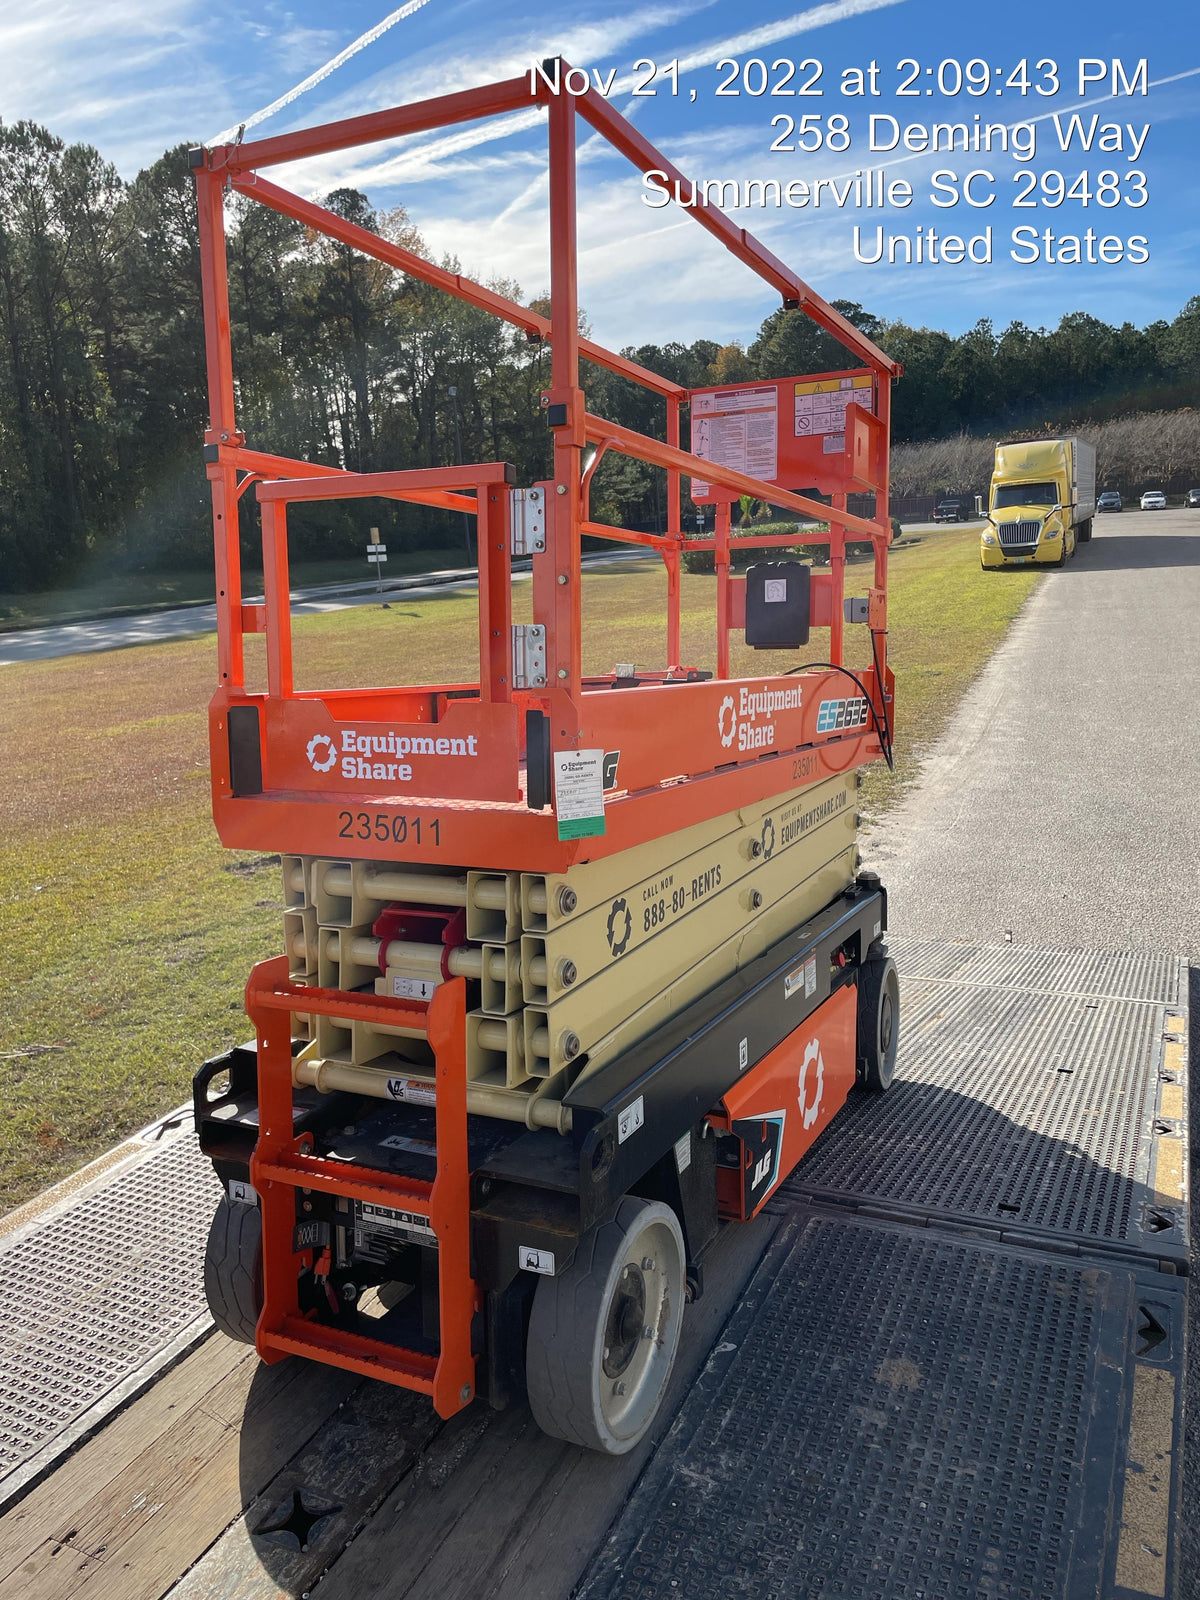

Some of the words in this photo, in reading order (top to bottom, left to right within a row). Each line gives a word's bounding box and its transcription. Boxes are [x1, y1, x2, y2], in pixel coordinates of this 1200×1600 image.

[739, 685, 803, 718] Equipment
[816, 696, 869, 734] ES2632
[341, 730, 478, 759] Equipment
[738, 722, 774, 751] Share
[341, 757, 413, 781] Share
[338, 811, 441, 846] 235011
[781, 790, 847, 845] EQUIPMENTSHARE.COM
[643, 884, 658, 901] CALL
[661, 875, 673, 891] NOW
[643, 863, 722, 932] 888-80-RENTS
[750, 1148, 772, 1191] JLG
